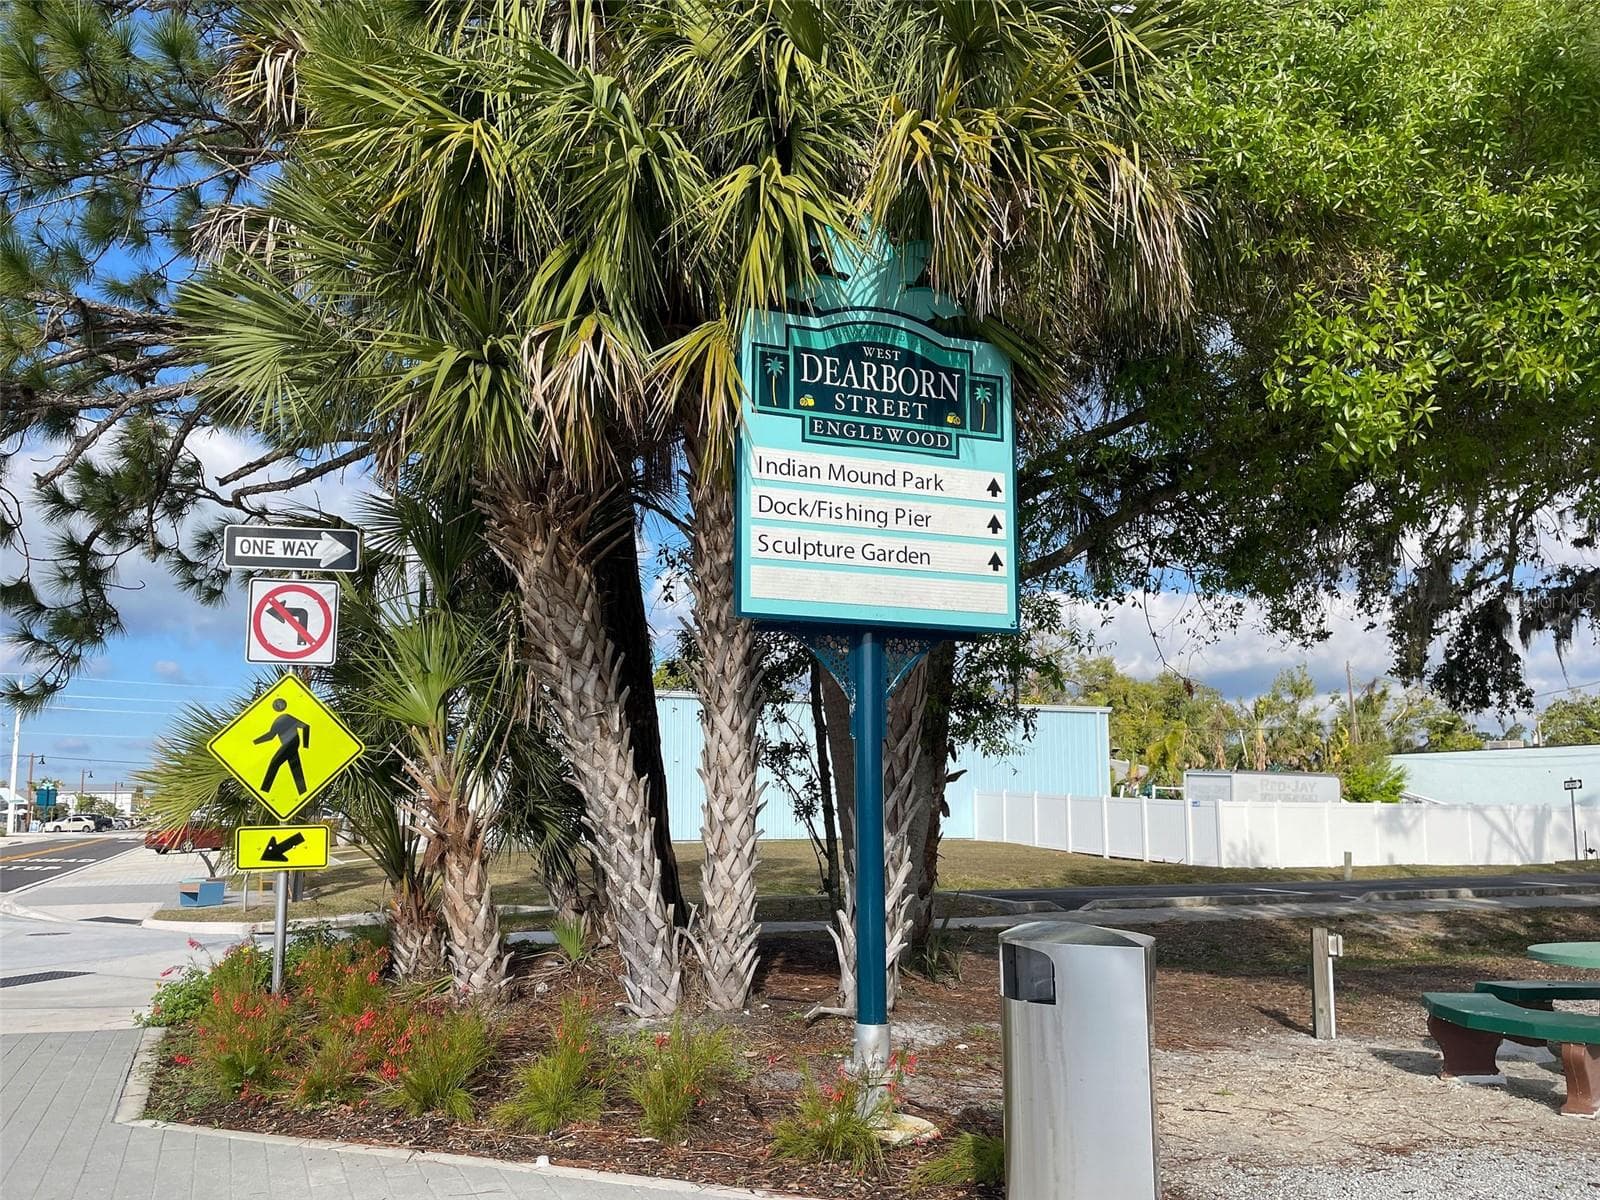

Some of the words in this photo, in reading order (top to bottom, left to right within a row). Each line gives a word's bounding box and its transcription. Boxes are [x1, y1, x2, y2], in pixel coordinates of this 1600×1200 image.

[862, 346, 901, 361] WEST
[800, 353, 961, 402] DEARBORN
[834, 393, 928, 420] STREET
[813, 419, 950, 448] ENGLEWOOD
[758, 455, 821, 479] Indian
[828, 463, 896, 487] Mound
[902, 471, 945, 492] Park
[758, 495, 888, 528] Dock/Fishing
[895, 508, 932, 528] Pier
[240, 539, 275, 555] ONE
[282, 541, 318, 556] WAY
[758, 534, 855, 560] Sculpture
[861, 543, 931, 565] Garden
